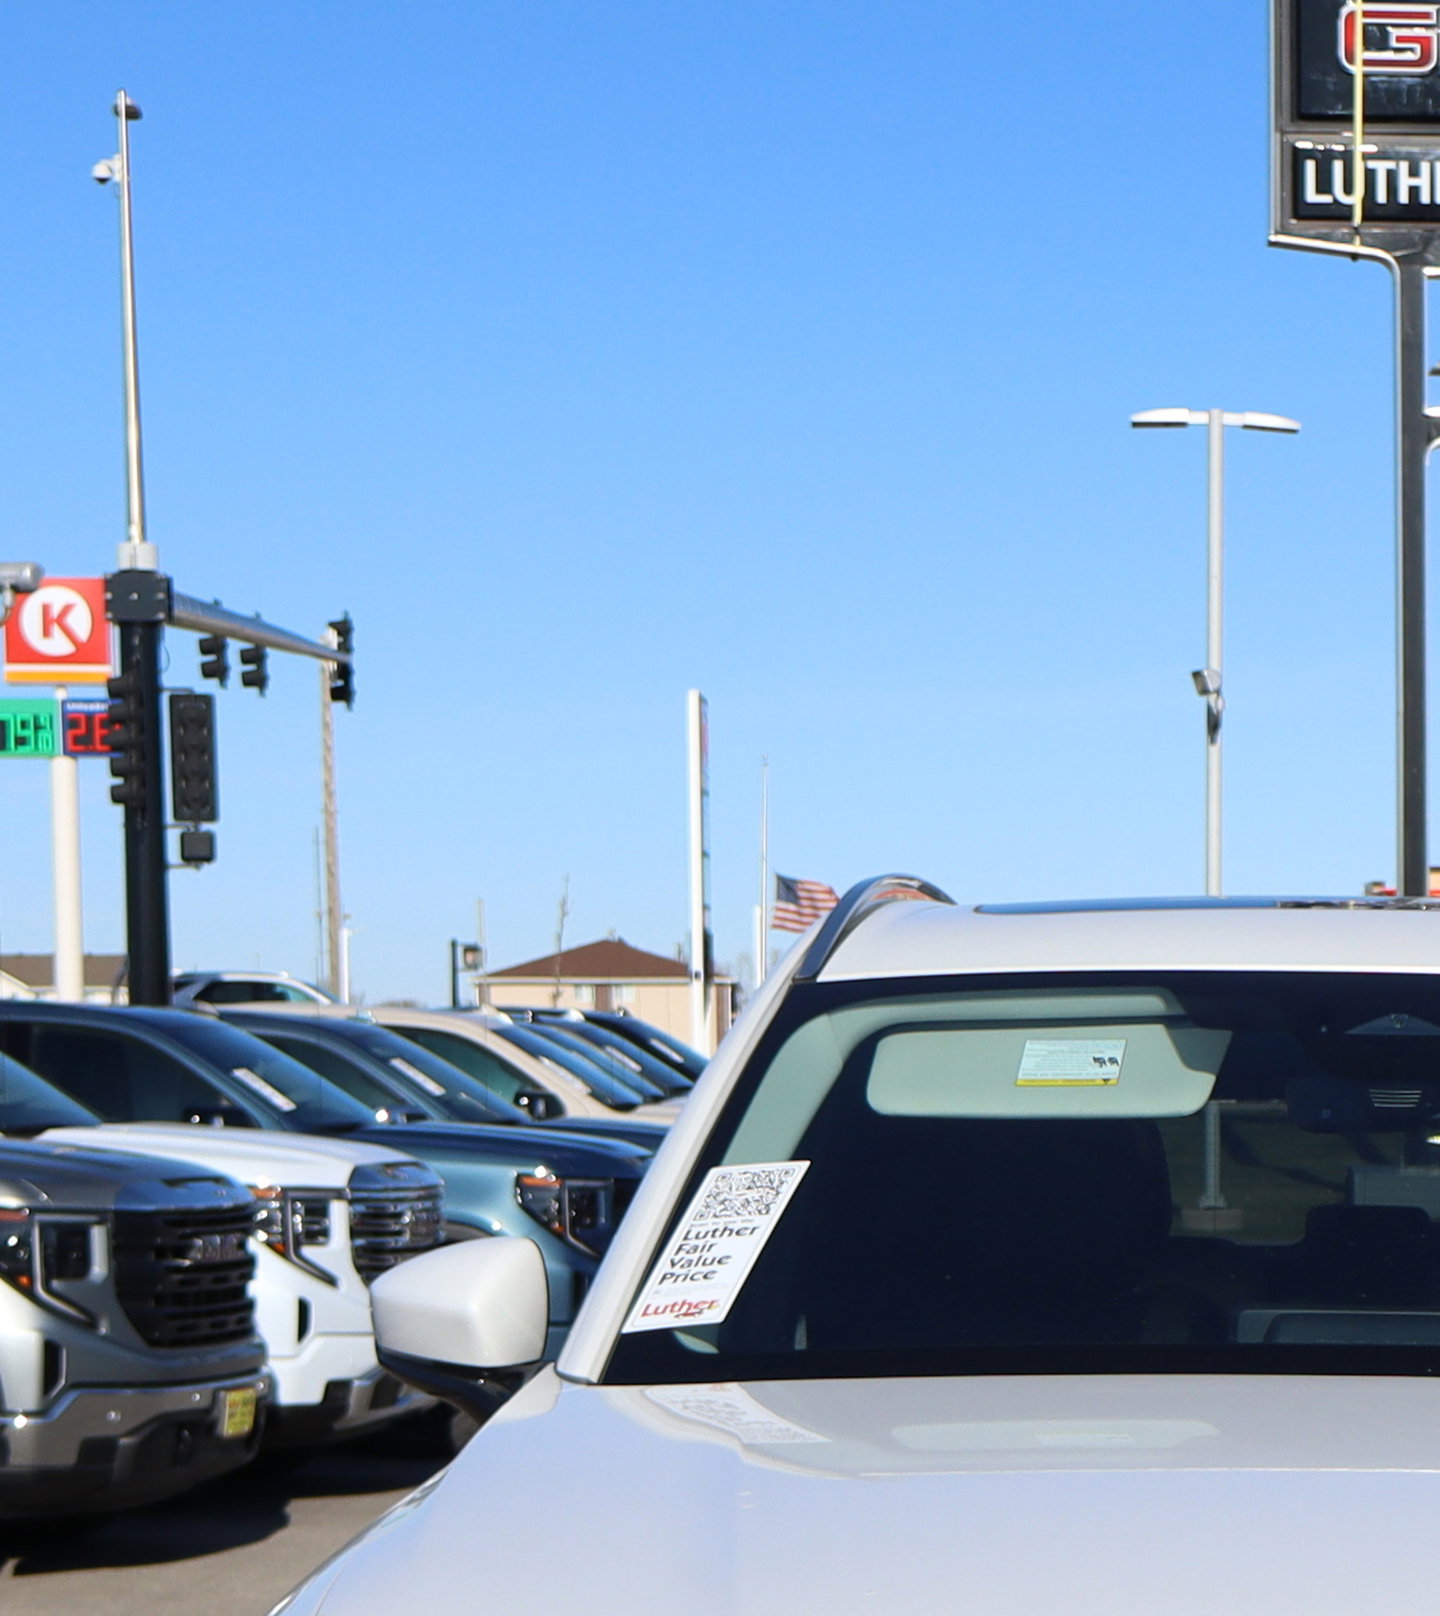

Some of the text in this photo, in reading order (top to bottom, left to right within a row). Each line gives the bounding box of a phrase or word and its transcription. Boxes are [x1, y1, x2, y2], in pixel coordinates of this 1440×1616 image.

[41, 602, 87, 650] K
[682, 1226, 761, 1242] Luther
[674, 1241, 719, 1257] Fair
[668, 1254, 733, 1270] Value
[657, 1270, 718, 1286] Price
[640, 1299, 720, 1319] Luther
